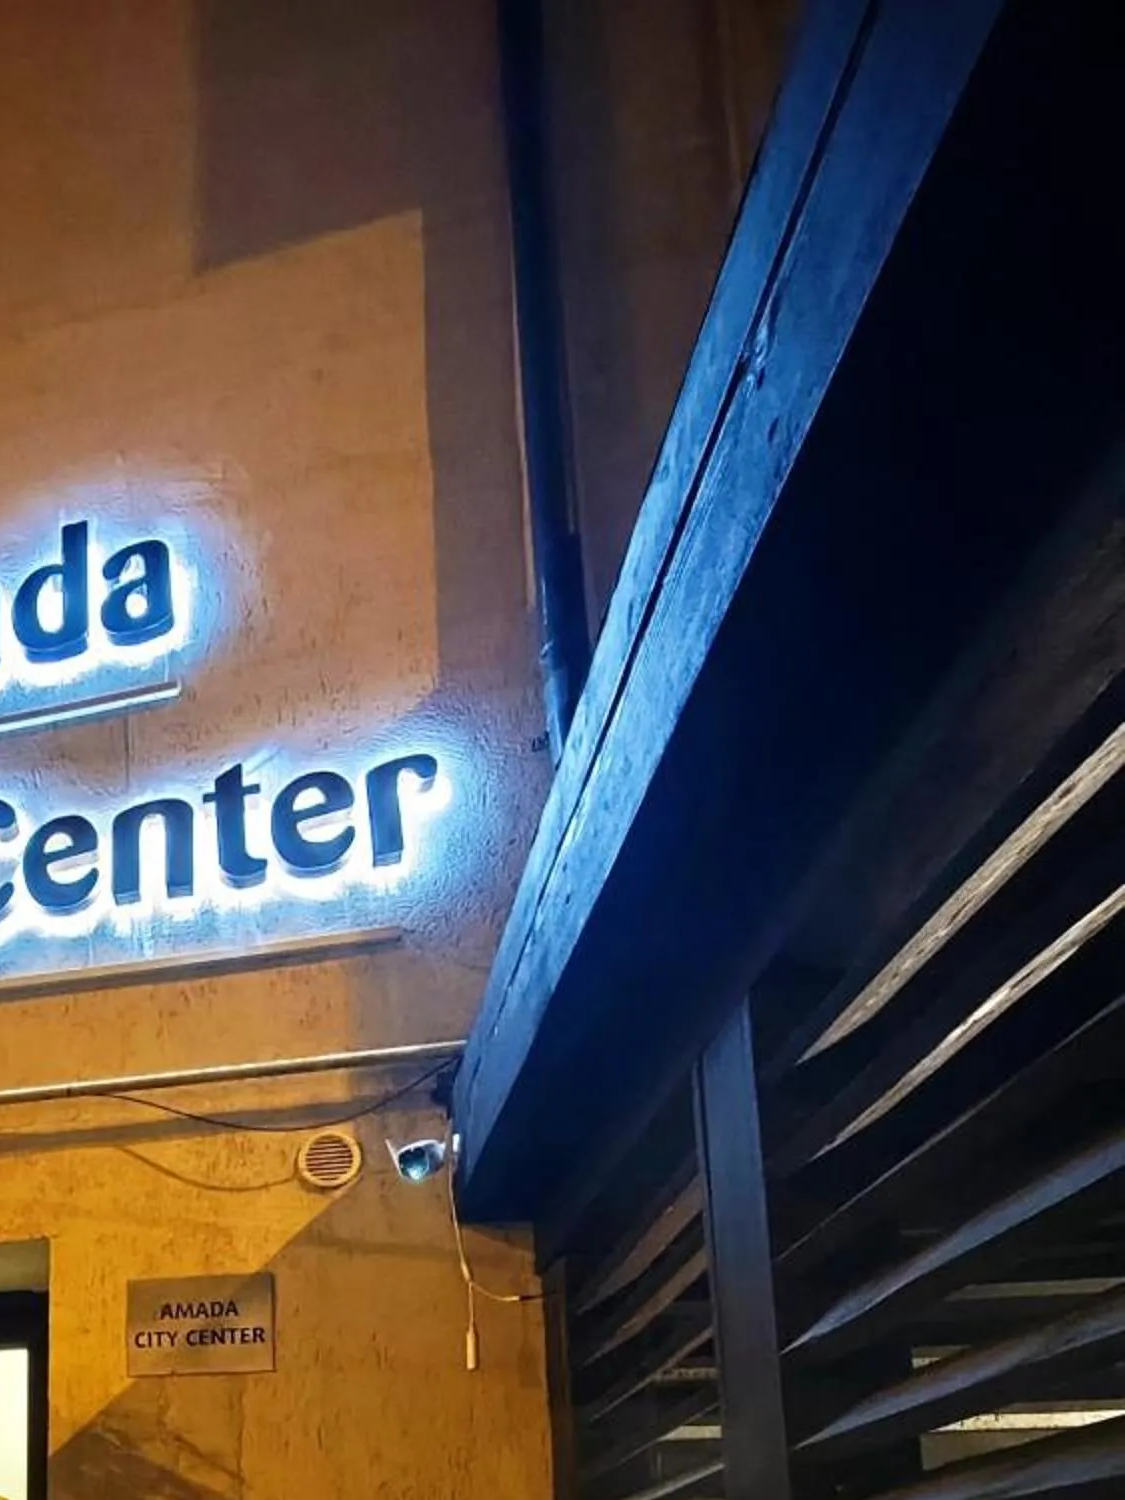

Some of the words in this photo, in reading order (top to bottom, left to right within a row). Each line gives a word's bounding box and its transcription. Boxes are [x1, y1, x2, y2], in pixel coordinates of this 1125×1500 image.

[160, 1300, 239, 1320] AMADA
[134, 1330, 178, 1349] CITY
[186, 1326, 266, 1347] CENTER
